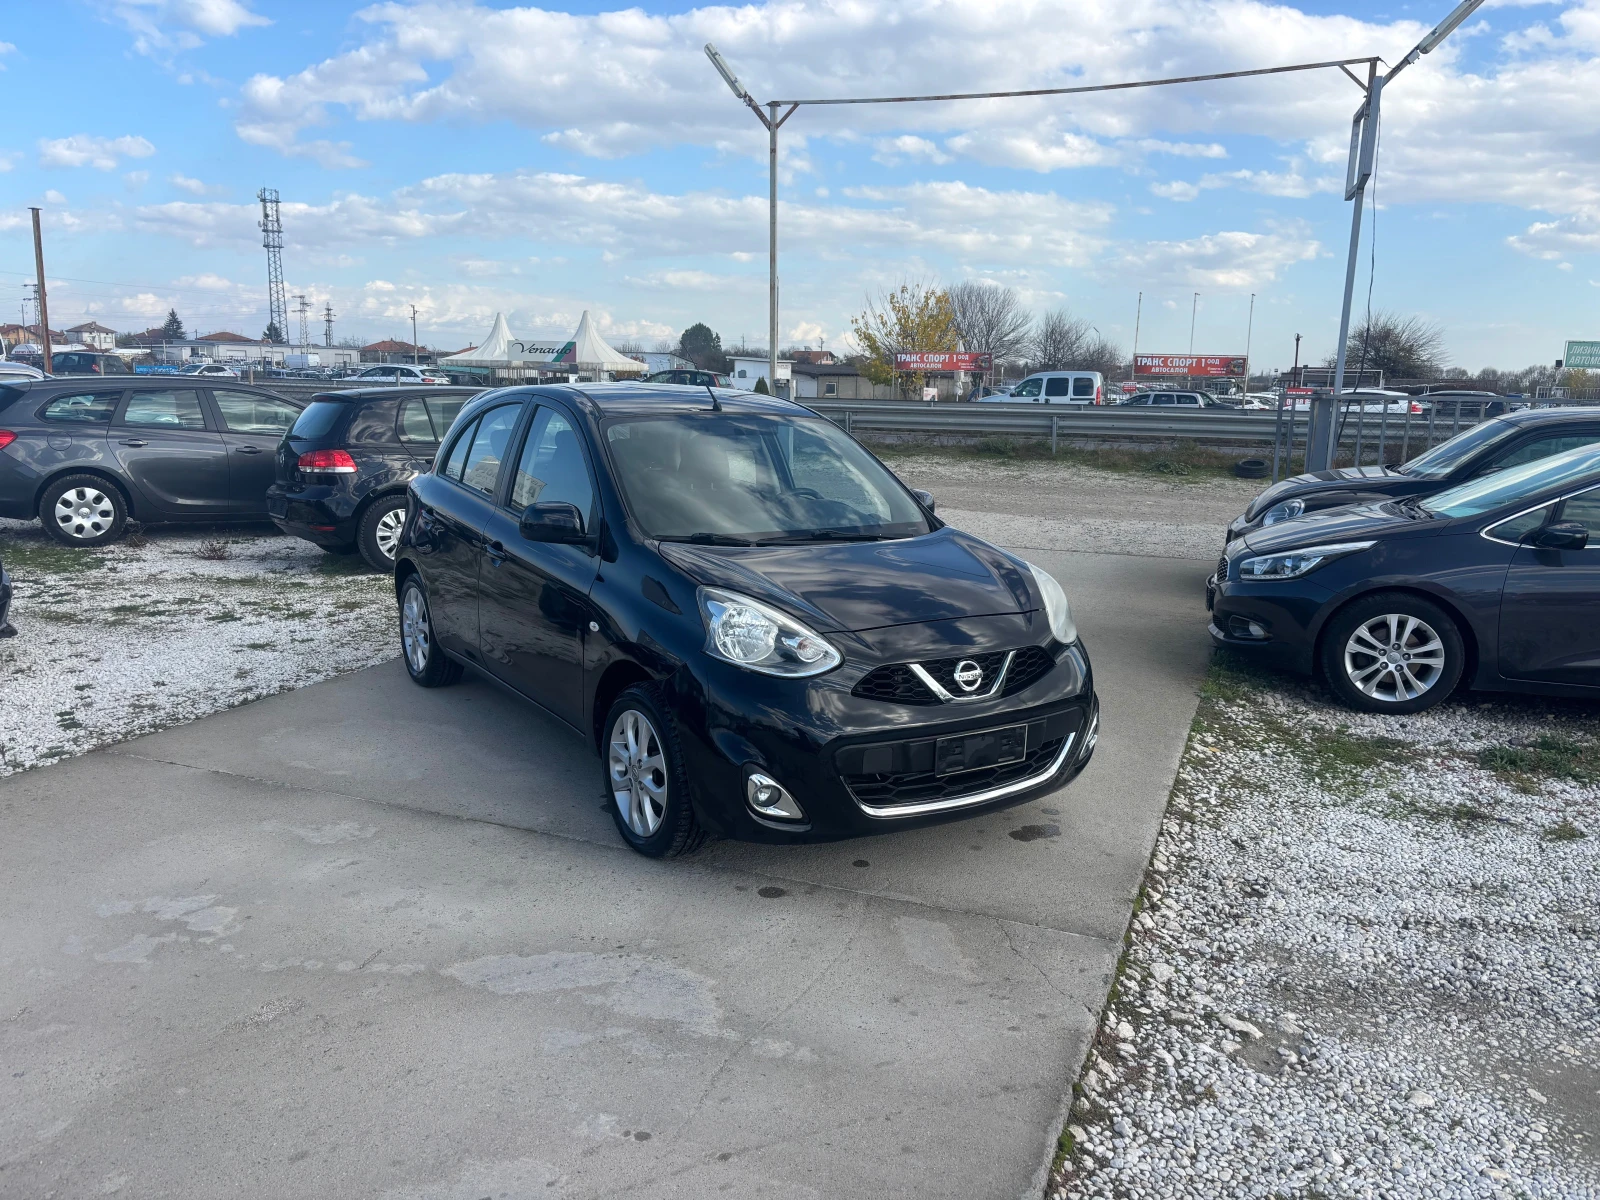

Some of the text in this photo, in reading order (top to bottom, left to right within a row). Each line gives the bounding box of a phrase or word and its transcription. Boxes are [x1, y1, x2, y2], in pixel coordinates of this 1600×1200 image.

[512, 342, 572, 355] Venauto
[896, 353, 921, 362] ТРАНС
[923, 354, 950, 363] СПОРТ
[1136, 357, 1165, 367] ТРАНС
[1167, 358, 1198, 367] СПОРТ
[1201, 358, 1206, 367] 1
